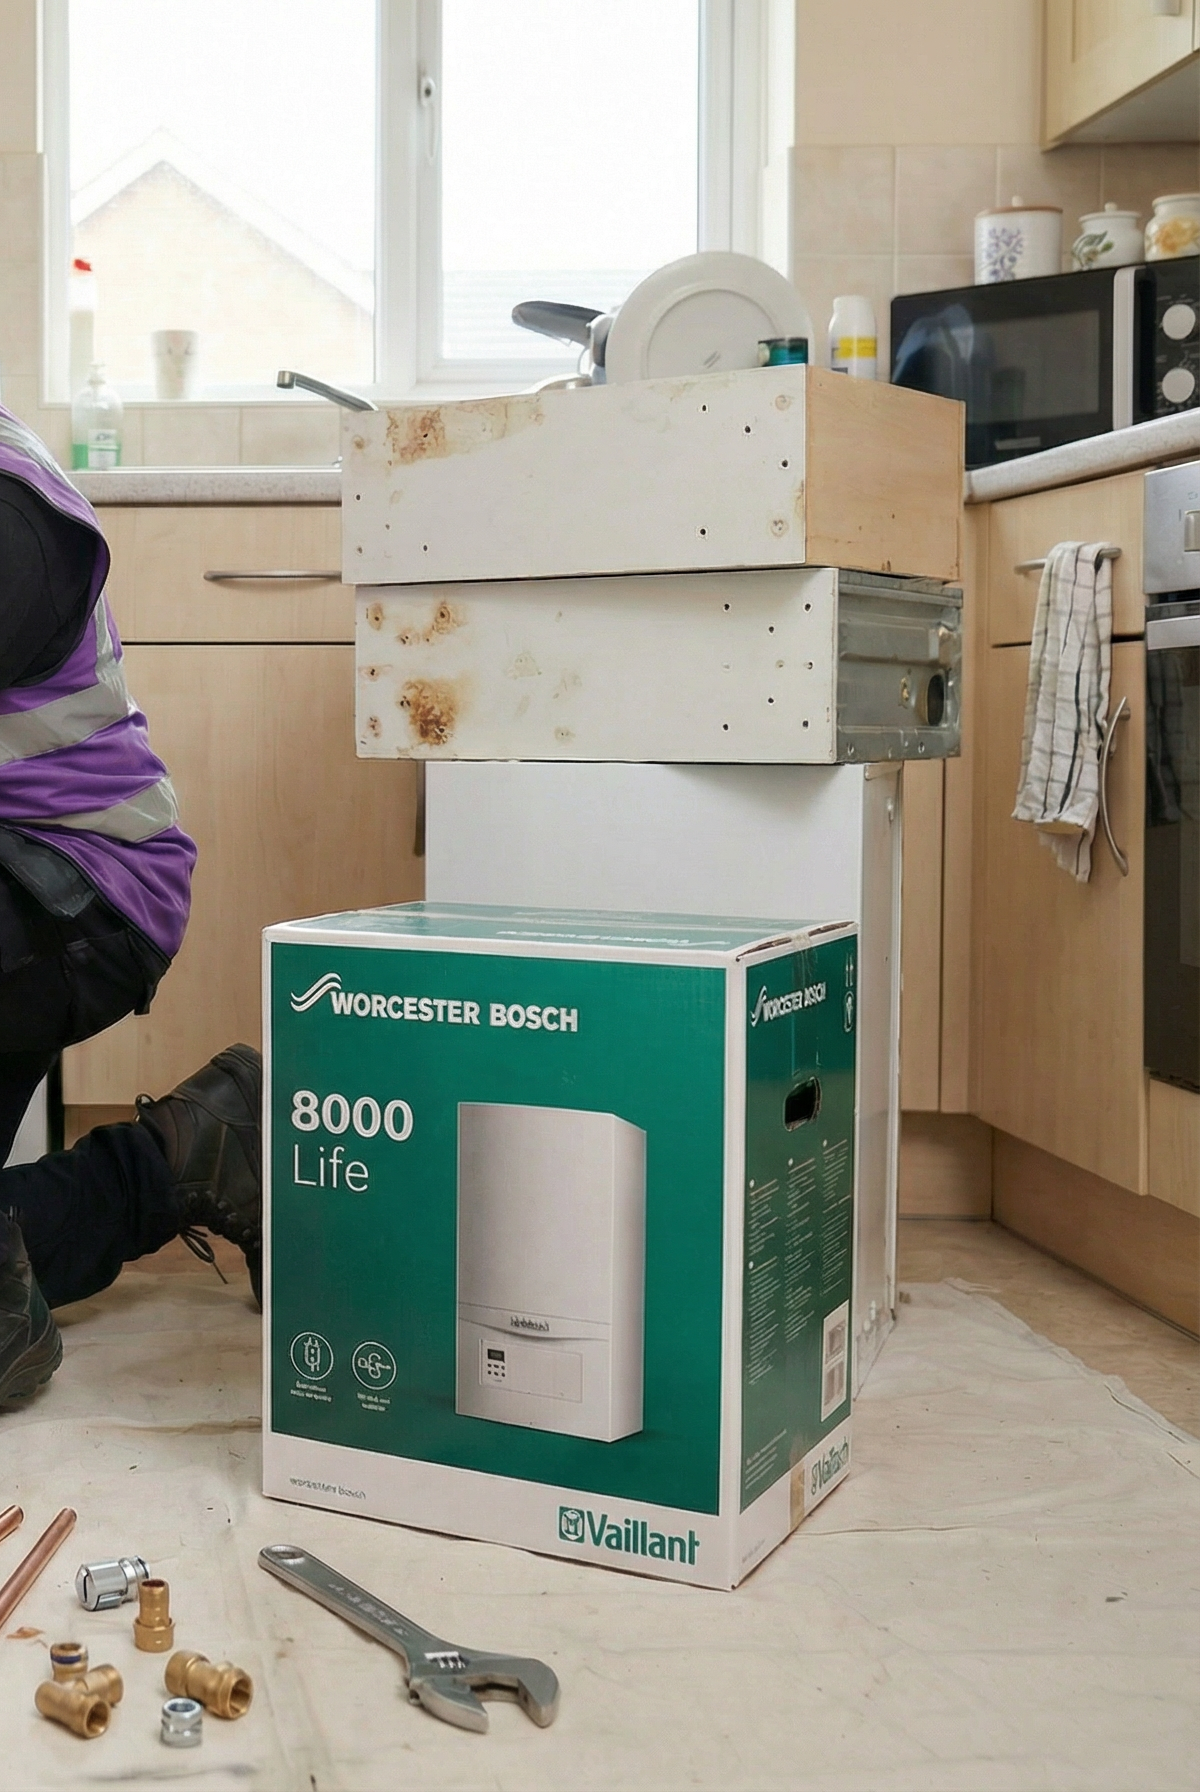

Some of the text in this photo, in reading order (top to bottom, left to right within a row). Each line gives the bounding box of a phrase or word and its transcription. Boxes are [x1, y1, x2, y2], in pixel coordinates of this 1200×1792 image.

[330, 991, 578, 1032] WORCESTER BOSCH
[291, 1090, 413, 1141] 8000
[294, 1144, 369, 1190] Life
[586, 1510, 700, 1565] Vaillant
